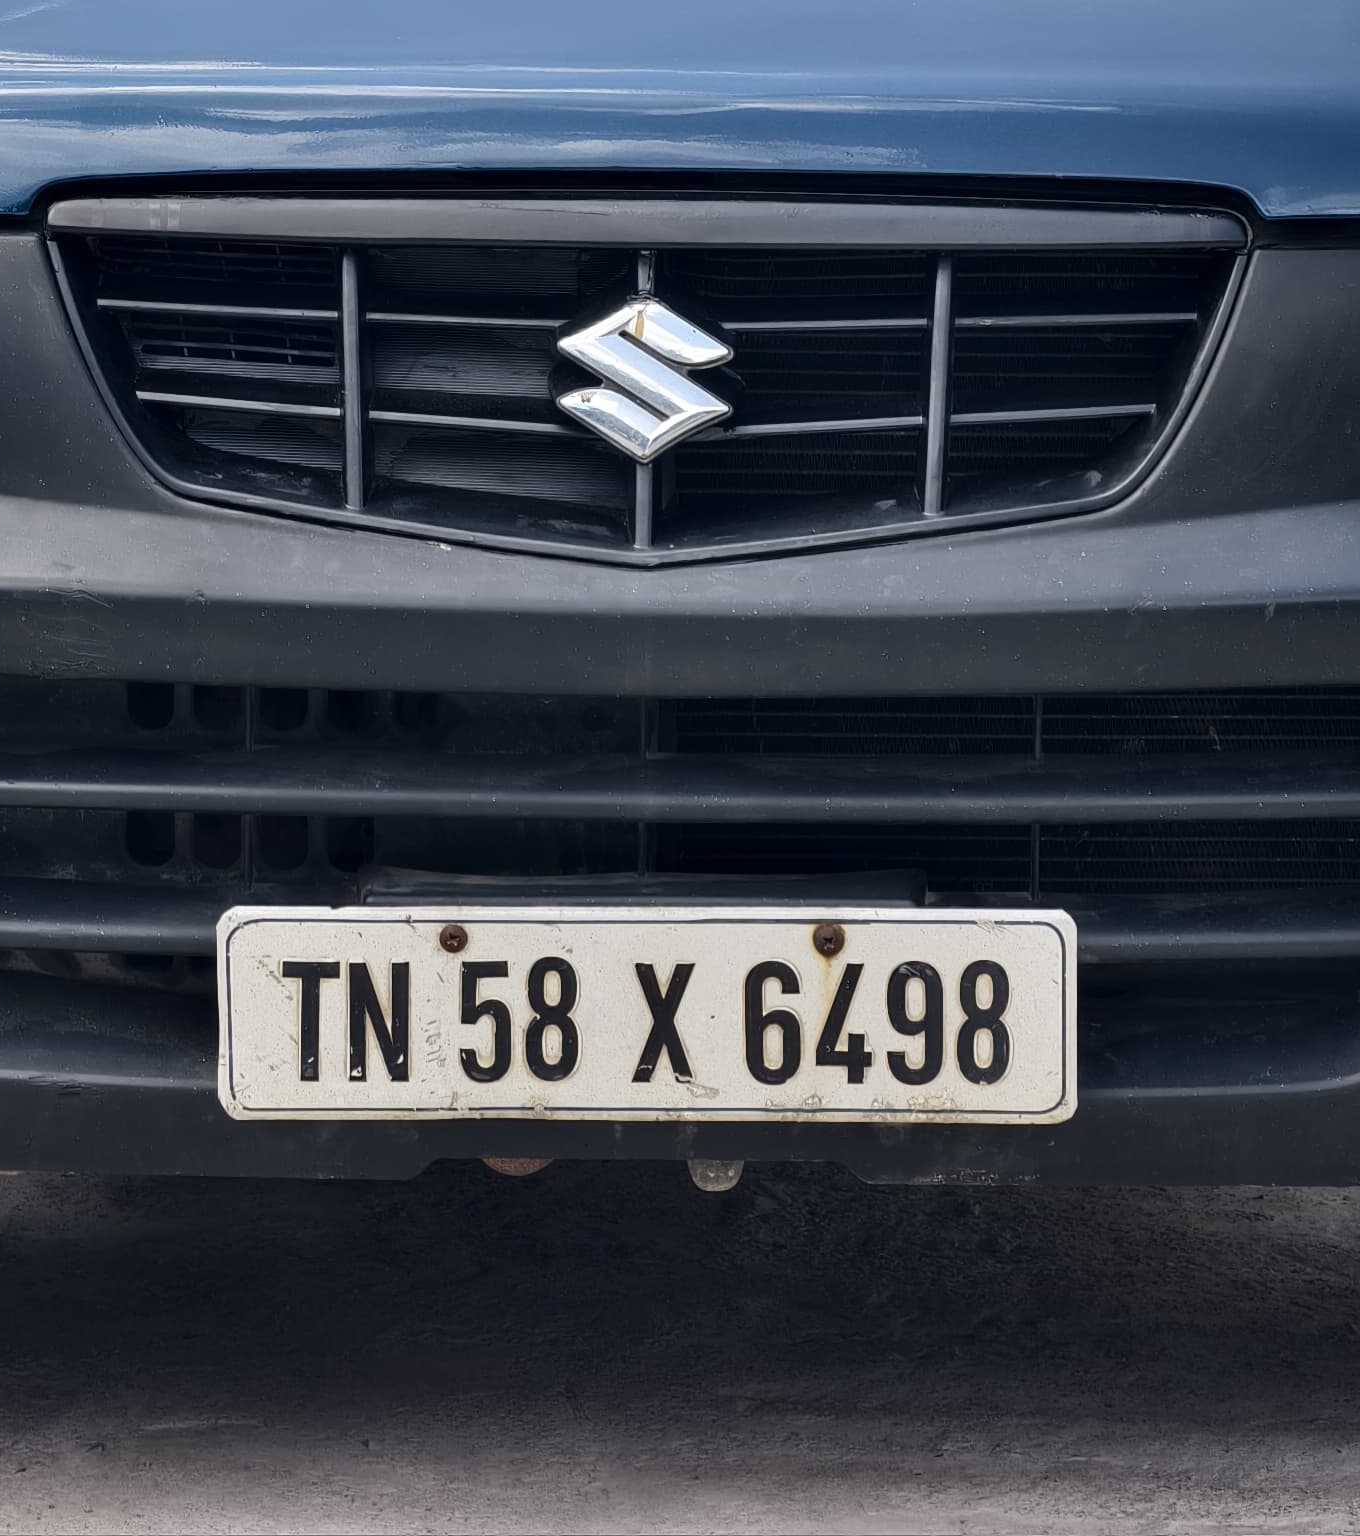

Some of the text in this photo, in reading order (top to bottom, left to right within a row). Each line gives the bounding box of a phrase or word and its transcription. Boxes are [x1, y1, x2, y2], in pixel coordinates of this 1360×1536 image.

[281, 956, 1011, 1086] TN 58 X 6498
